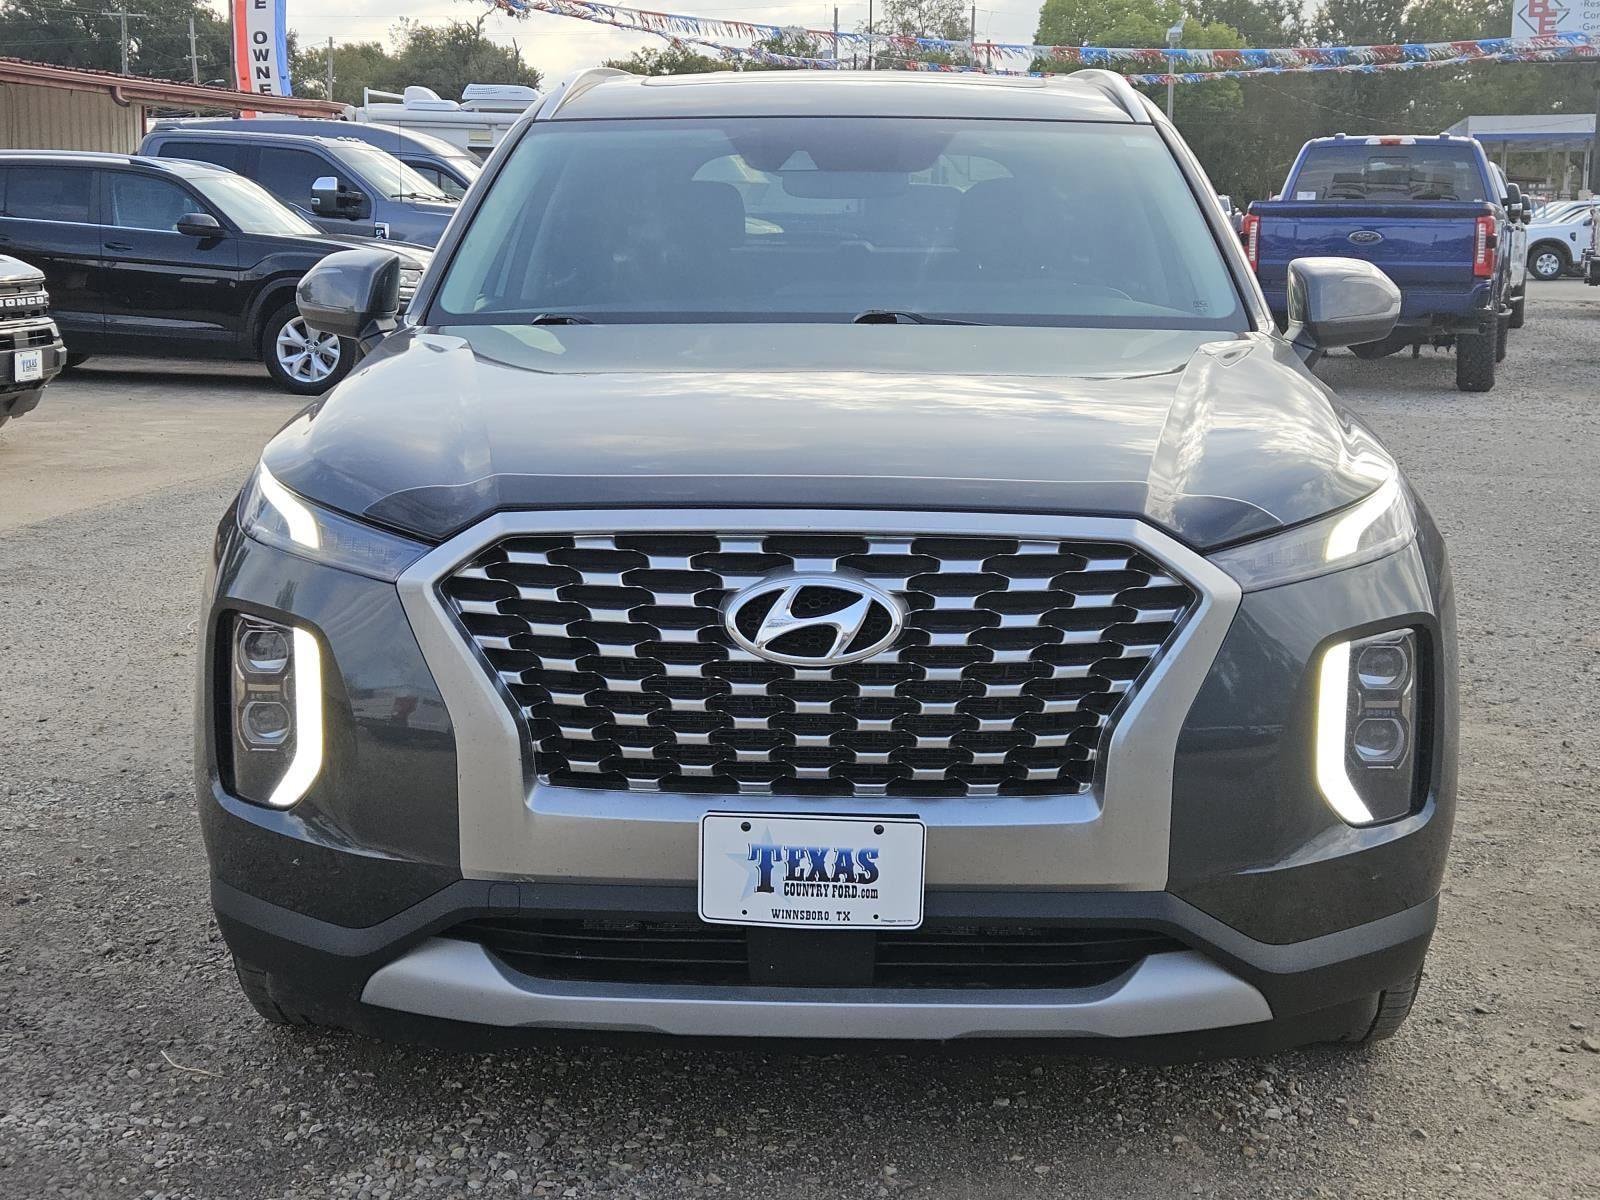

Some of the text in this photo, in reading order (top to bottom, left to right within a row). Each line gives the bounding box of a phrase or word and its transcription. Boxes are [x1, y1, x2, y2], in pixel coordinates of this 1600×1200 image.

[747, 843, 880, 893] TEXAS
[783, 882, 879, 899] COUNTRY FORD.com
[836, 911, 851, 921] TX
